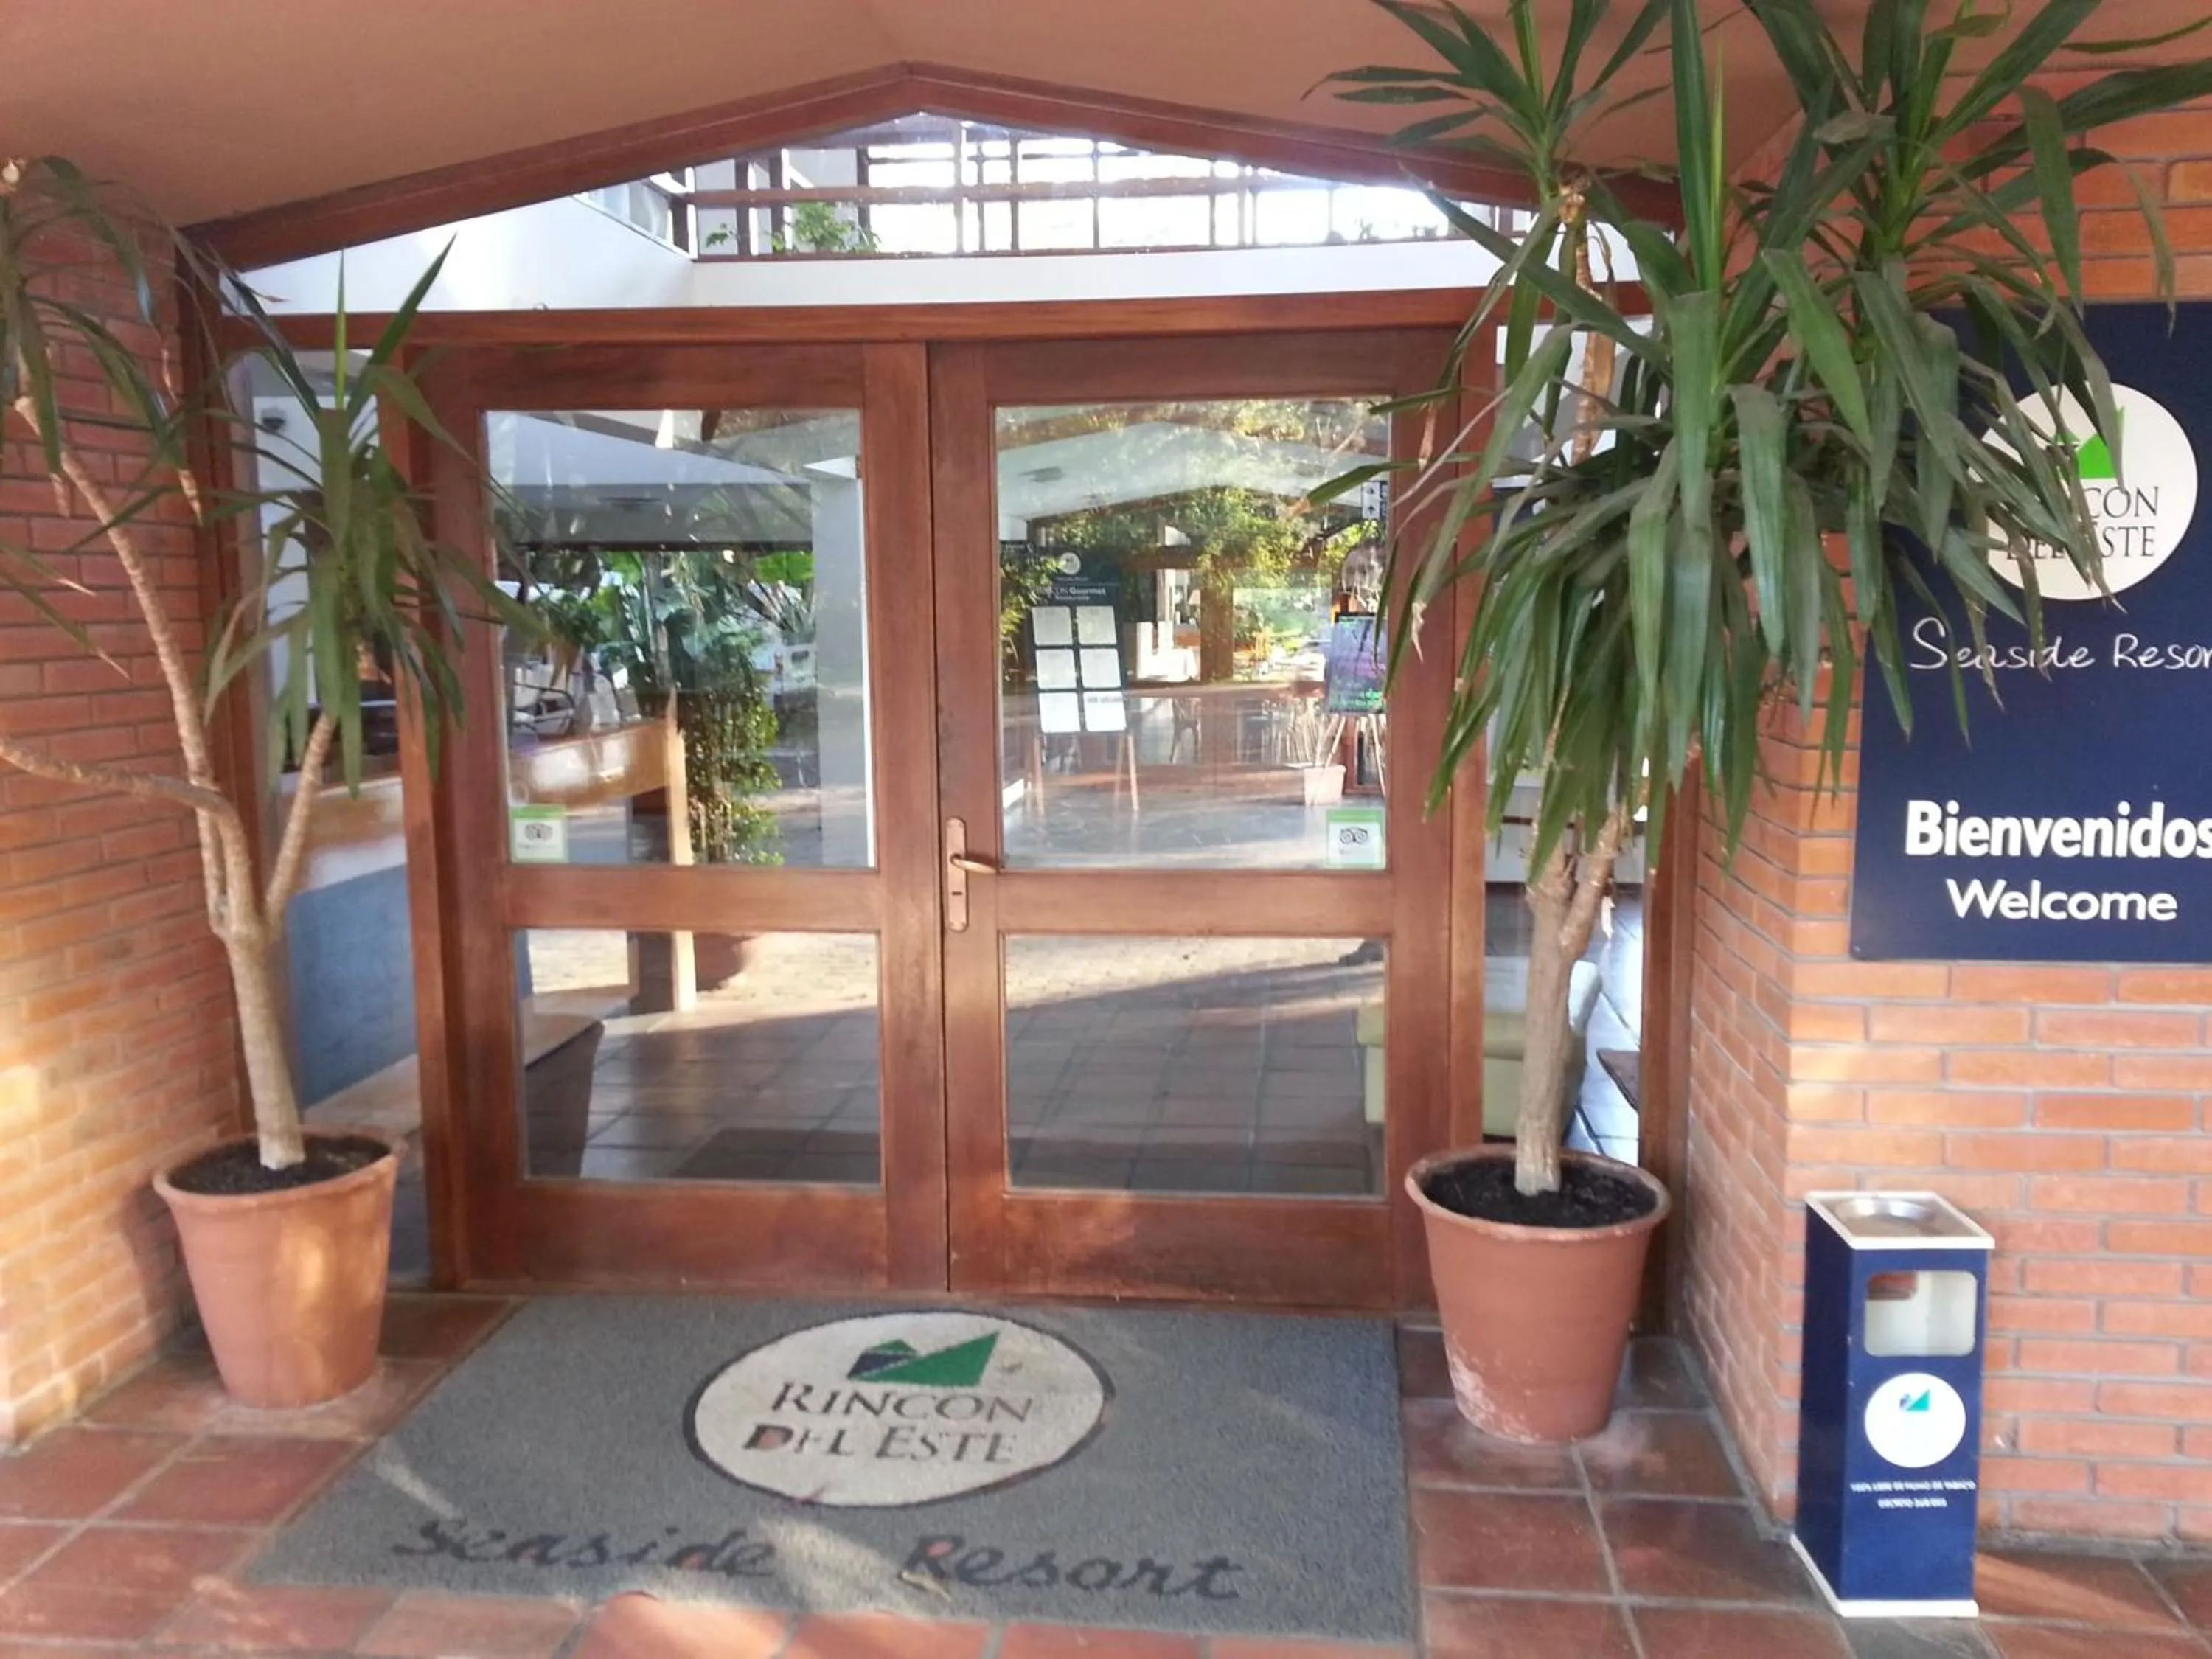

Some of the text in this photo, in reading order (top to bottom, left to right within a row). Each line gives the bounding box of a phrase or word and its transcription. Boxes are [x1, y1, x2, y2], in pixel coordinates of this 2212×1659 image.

[2083, 487, 2159, 518] CON
[2092, 521, 2155, 558] STE
[1910, 617, 2095, 669] Seaside
[1905, 800, 2212, 858] Bienvenidos
[1946, 878, 2177, 921] Welcome
[771, 1381, 1034, 1423] RINCON
[875, 1424, 1018, 1464] ESTE
[391, 1520, 1245, 1599] Seaside Resort
